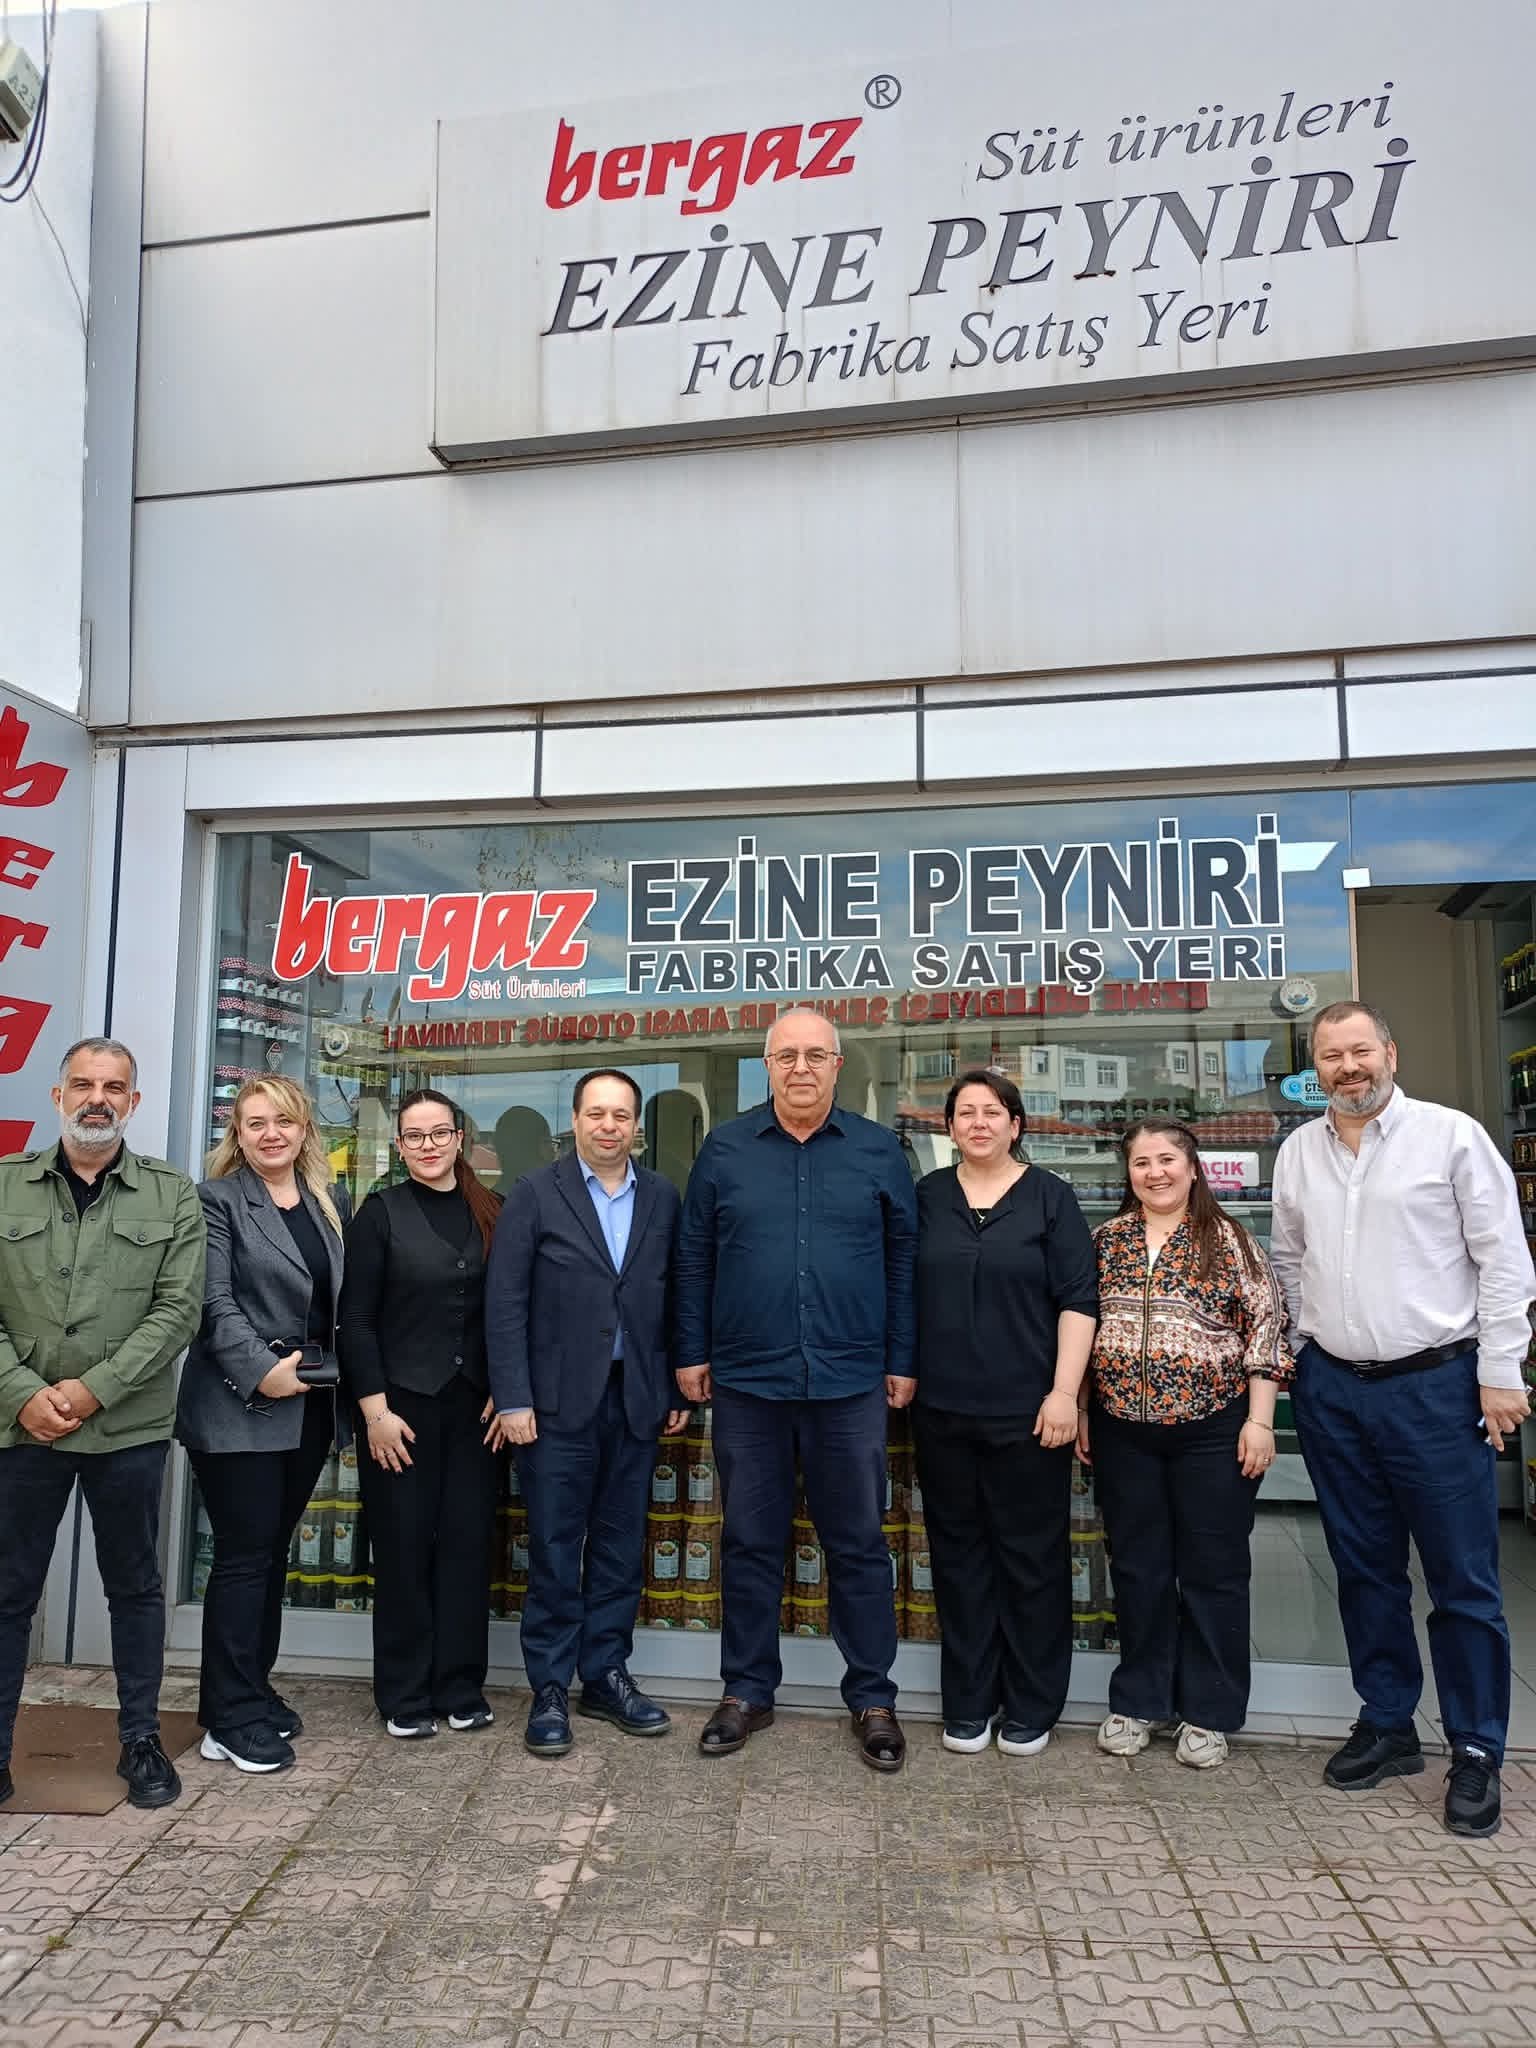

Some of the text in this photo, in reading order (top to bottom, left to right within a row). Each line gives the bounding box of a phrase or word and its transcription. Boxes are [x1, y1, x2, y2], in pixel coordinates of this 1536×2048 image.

[546, 117, 863, 216] bergaz
[977, 82, 1394, 182] Süt ürünleri
[540, 137, 1416, 337] EZİNE PEYNİRİ
[680, 283, 1272, 395] Fabrika Satış Yeri
[272, 852, 597, 1002] bergaz
[628, 813, 1284, 945] EZİNE PEYNİRİ
[469, 976, 586, 999] Süt Ürünleri
[912, 938, 1104, 995] SATIŞ
